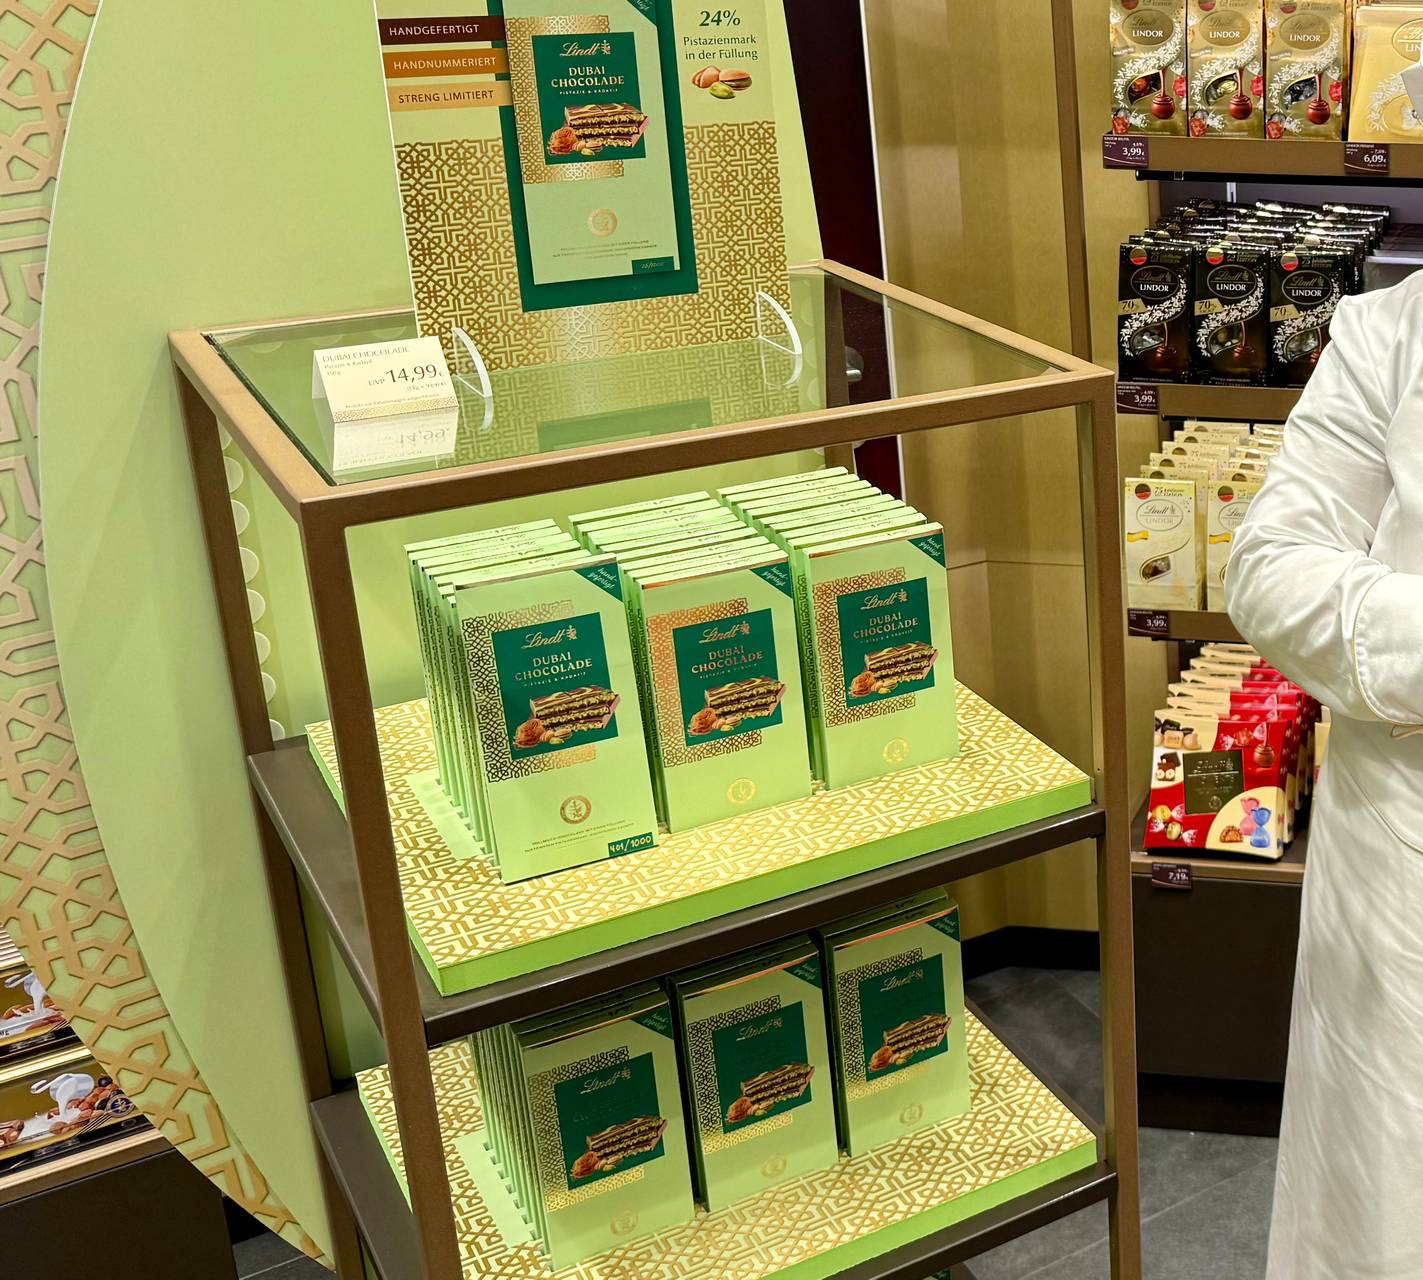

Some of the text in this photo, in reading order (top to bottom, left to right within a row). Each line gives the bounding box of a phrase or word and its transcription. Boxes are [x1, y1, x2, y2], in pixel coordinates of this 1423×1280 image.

[699, 9, 741, 27] 24%
[389, 24, 480, 36] HANDGEFERTIGT
[1132, 29, 1164, 38] LINDOR
[1209, 30, 1241, 39] LINDOR
[683, 35, 757, 46] Pistazienmark
[1289, 34, 1321, 42] LINDOR
[559, 41, 600, 57] Lindt
[685, 48, 759, 61] in der Füllung
[393, 56, 496, 70] HANDNUMMERIERT
[568, 66, 605, 76] DUBAI
[551, 75, 625, 88] CHOCOLADE
[398, 90, 494, 104] STRENG LIMITIERT
[1140, 283, 1169, 292] LINDOR
[1216, 283, 1246, 292] LINDOR
[1292, 289, 1322, 297] LINDOR
[860, 592, 898, 611] Lindt
[869, 612, 902, 626] DUBAI
[699, 624, 740, 644] Lindt
[853, 617, 918, 640] CHOCOLADE
[521, 628, 566, 649] Lindt
[533, 651, 572, 668] DUBAI
[708, 645, 744, 660] DUBAI
[514, 658, 593, 681] CHOCOLADE
[691, 651, 764, 674] CHOCOLADE
[580, 1070, 620, 1094] Lindt
